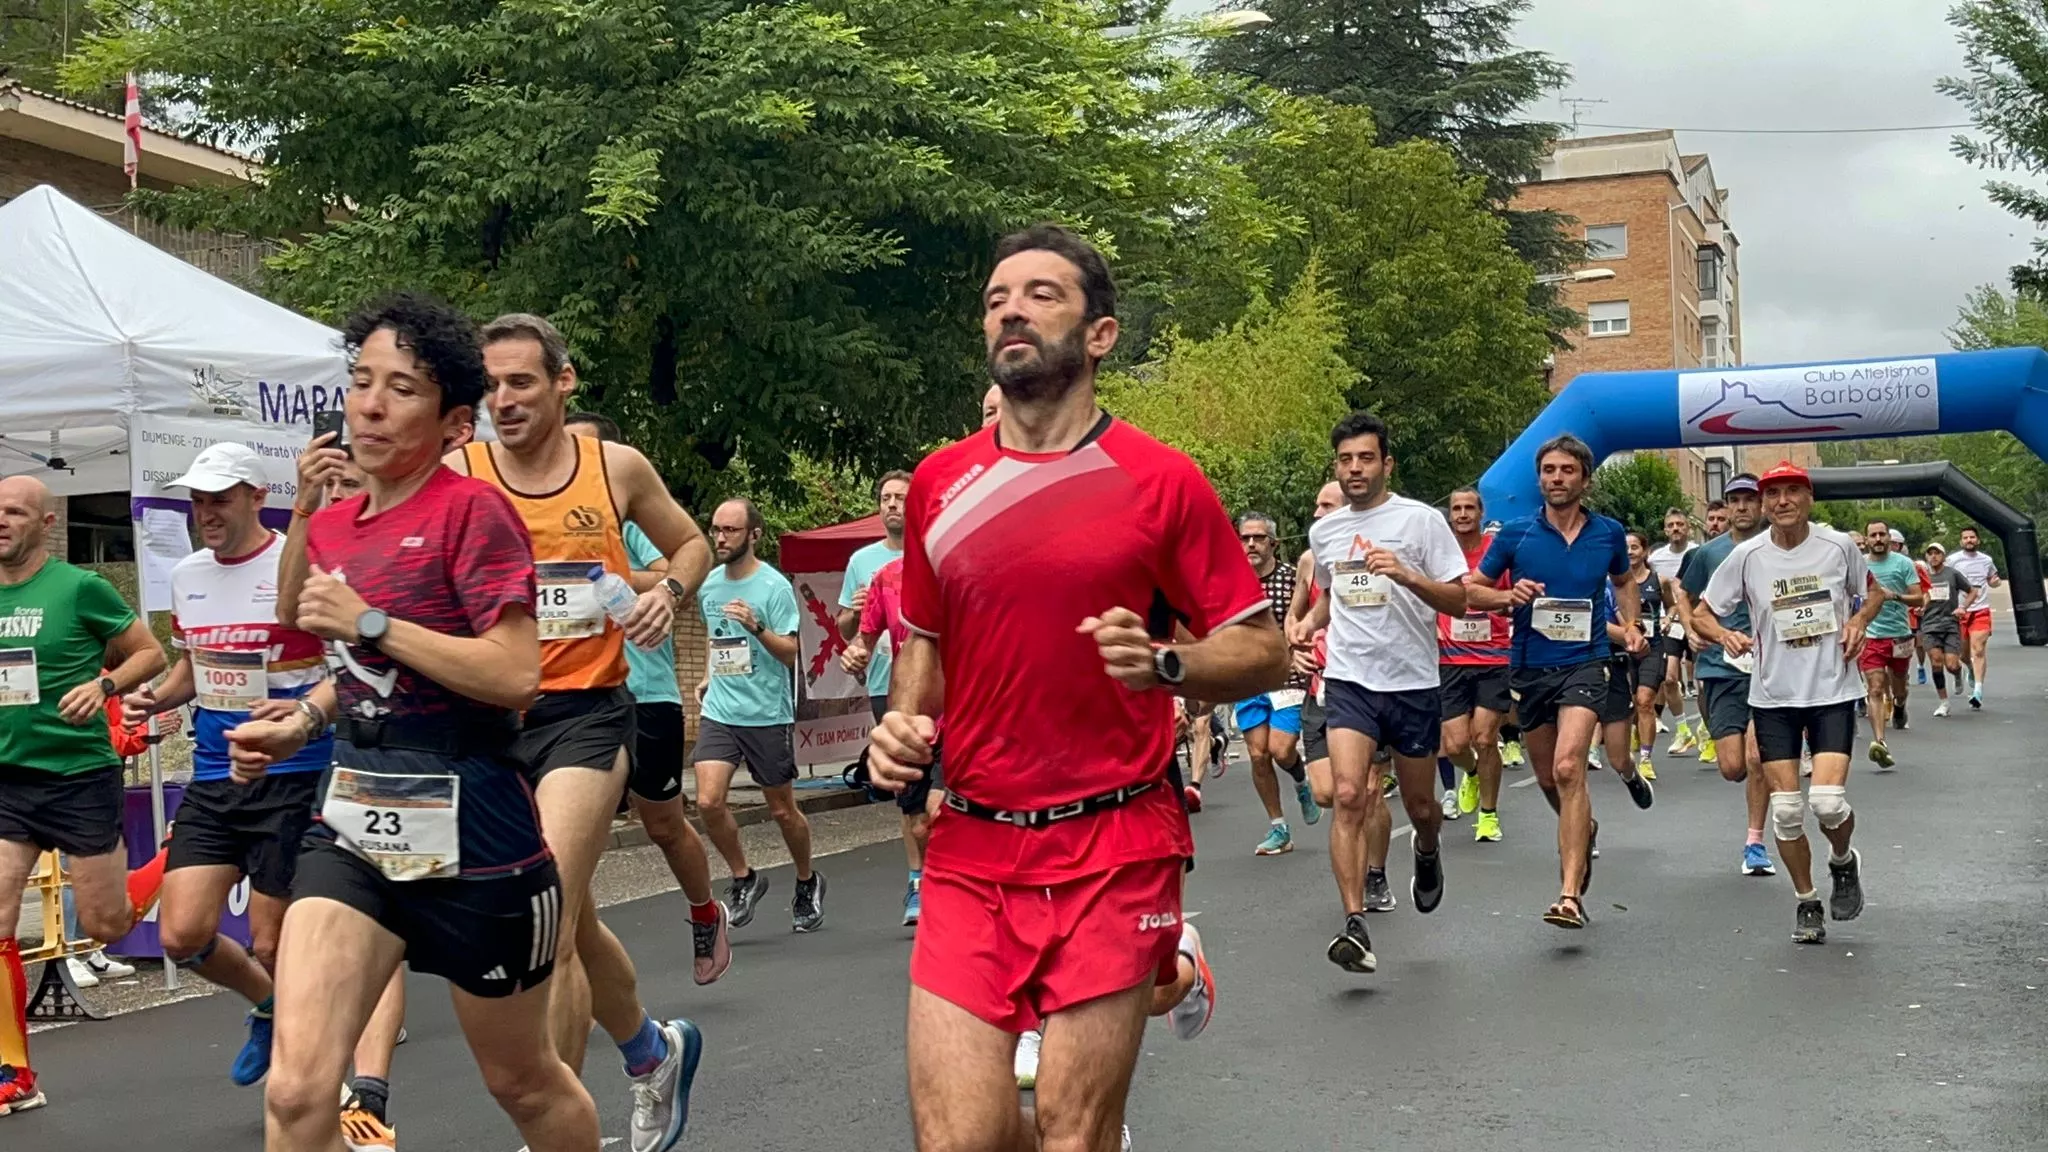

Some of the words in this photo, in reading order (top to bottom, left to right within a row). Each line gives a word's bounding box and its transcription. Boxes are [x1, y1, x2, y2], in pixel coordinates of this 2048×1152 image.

[1804, 369, 1845, 384] Club
[1850, 365, 1930, 381] Atletismo
[1805, 382, 1931, 406] Barbastro
[256, 442, 290, 459] Marató
[1351, 574, 1369, 586] 48
[538, 588, 567, 606] 18
[1554, 613, 1571, 624] 55
[1795, 607, 1814, 620] 28
[1464, 622, 1477, 630] 19
[719, 650, 731, 660] 51
[204, 670, 248, 686] 1003
[364, 809, 402, 836] 23
[359, 839, 412, 852] SUSANA
